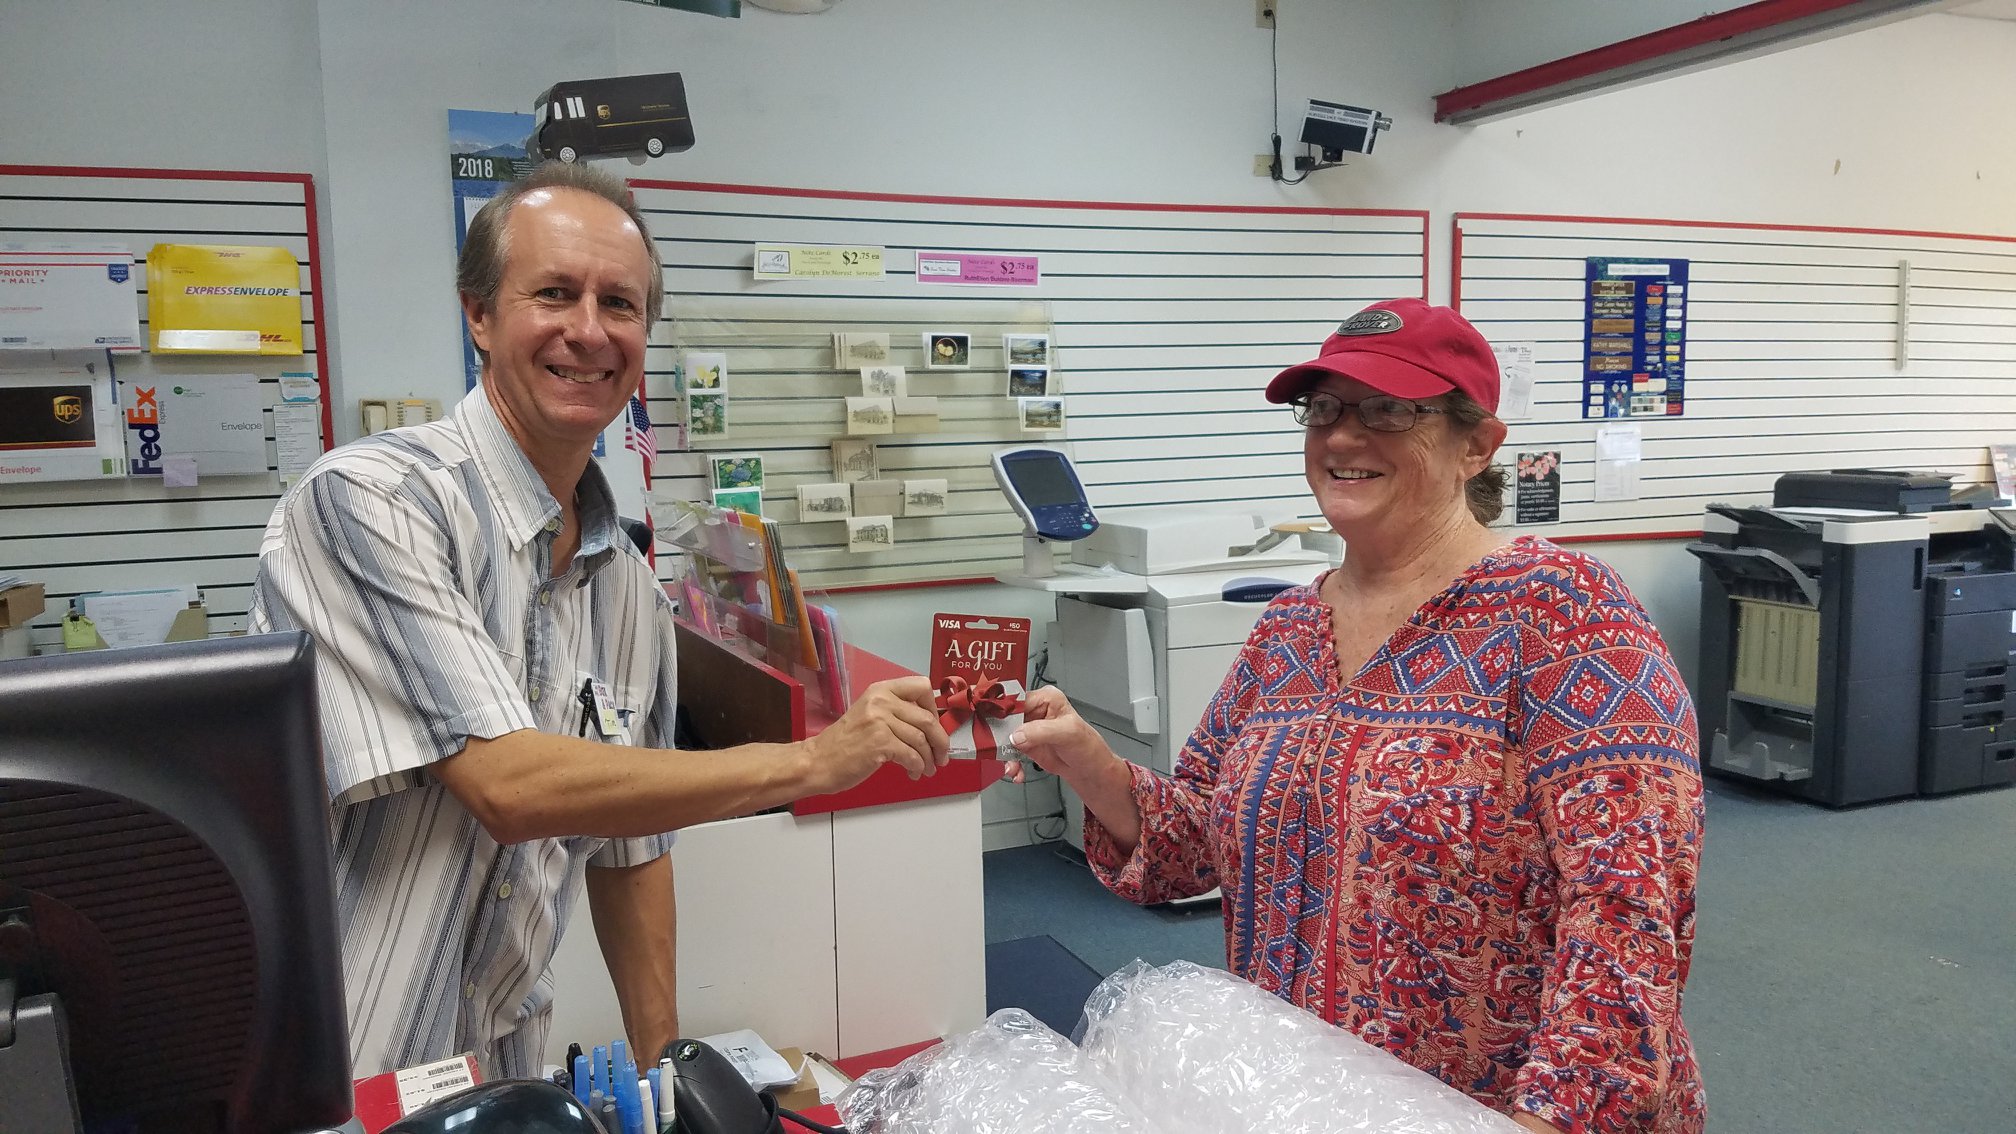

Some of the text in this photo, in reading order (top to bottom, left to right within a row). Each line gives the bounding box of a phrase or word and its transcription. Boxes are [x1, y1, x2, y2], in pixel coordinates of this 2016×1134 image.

[459, 158, 493, 178] 2018
[0, 269, 48, 277] PRIORITY
[185, 286, 289, 297] EXPRESSENVELOPE
[1349, 320, 1389, 330] ROVER
[56, 404, 80, 420] ups
[127, 386, 163, 475] FedEx
[221, 422, 262, 431] Envelope
[0, 465, 41, 474] Envelope
[938, 619, 961, 630] VISA
[944, 639, 1016, 671] A GIFT
[984, 662, 1003, 671] YOU
